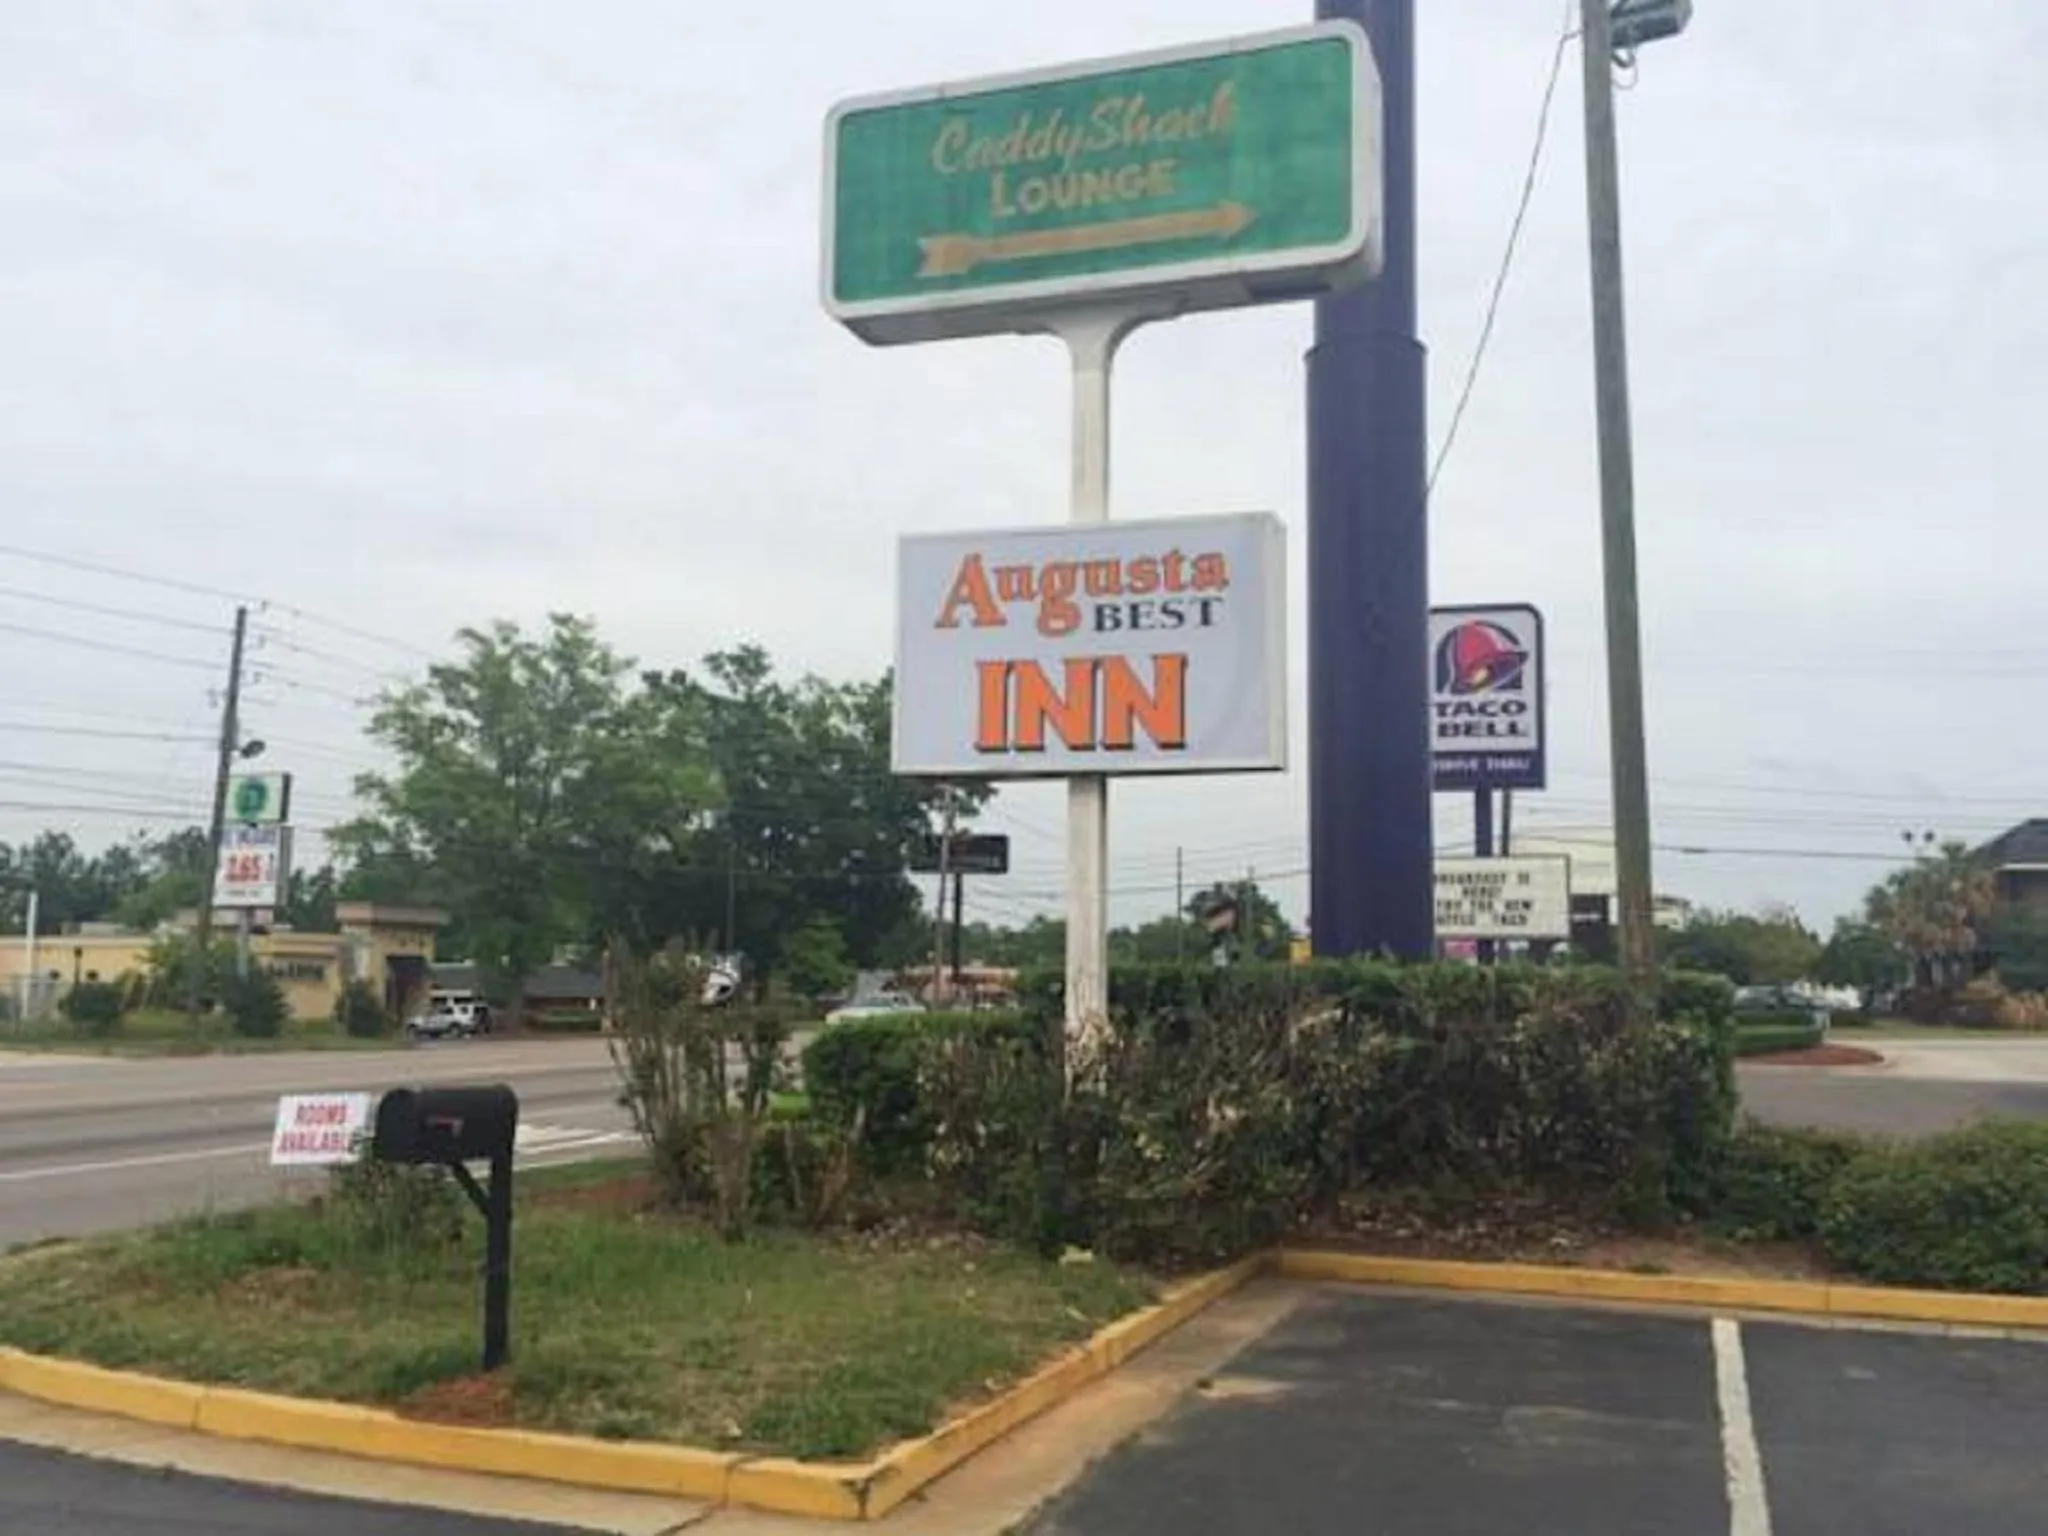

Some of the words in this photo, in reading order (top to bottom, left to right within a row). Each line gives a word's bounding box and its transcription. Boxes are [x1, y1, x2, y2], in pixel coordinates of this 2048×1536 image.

[988, 157, 1180, 218] LOUNGE
[934, 548, 1230, 638] Augusta
[1092, 595, 1226, 634] BEST
[975, 652, 1188, 752] INN
[1435, 699, 1528, 719] TACO
[1436, 720, 1531, 738] BELL
[296, 1102, 349, 1126] ROOMS
